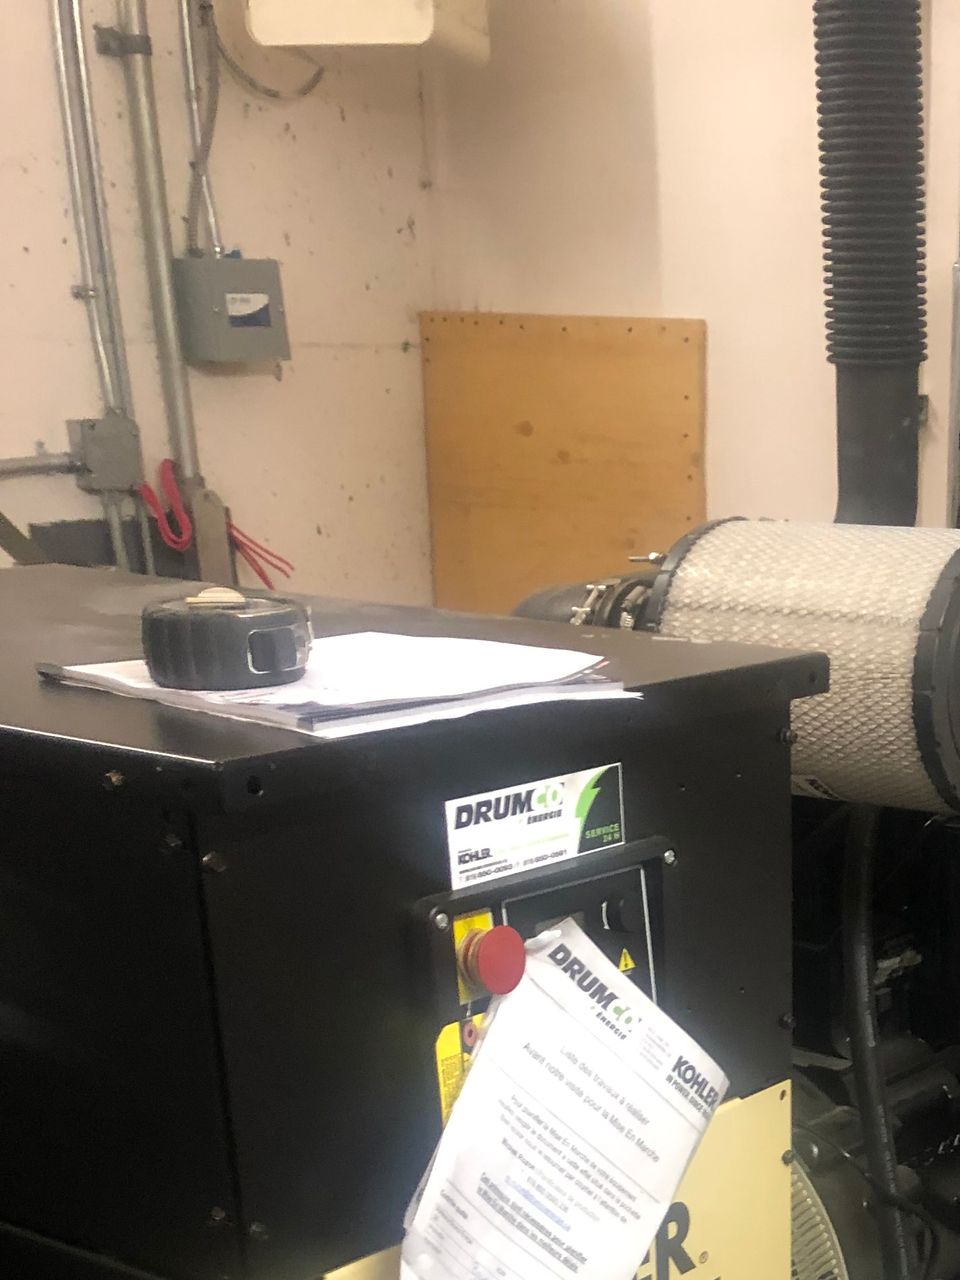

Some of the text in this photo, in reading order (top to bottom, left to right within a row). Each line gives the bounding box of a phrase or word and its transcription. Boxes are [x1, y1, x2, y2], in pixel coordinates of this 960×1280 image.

[585, 823, 620, 839] SERVICE
[457, 847, 494, 866] KOHLER
[547, 943, 642, 1033] DRUMCO
[671, 1055, 720, 1108] KOHLER
